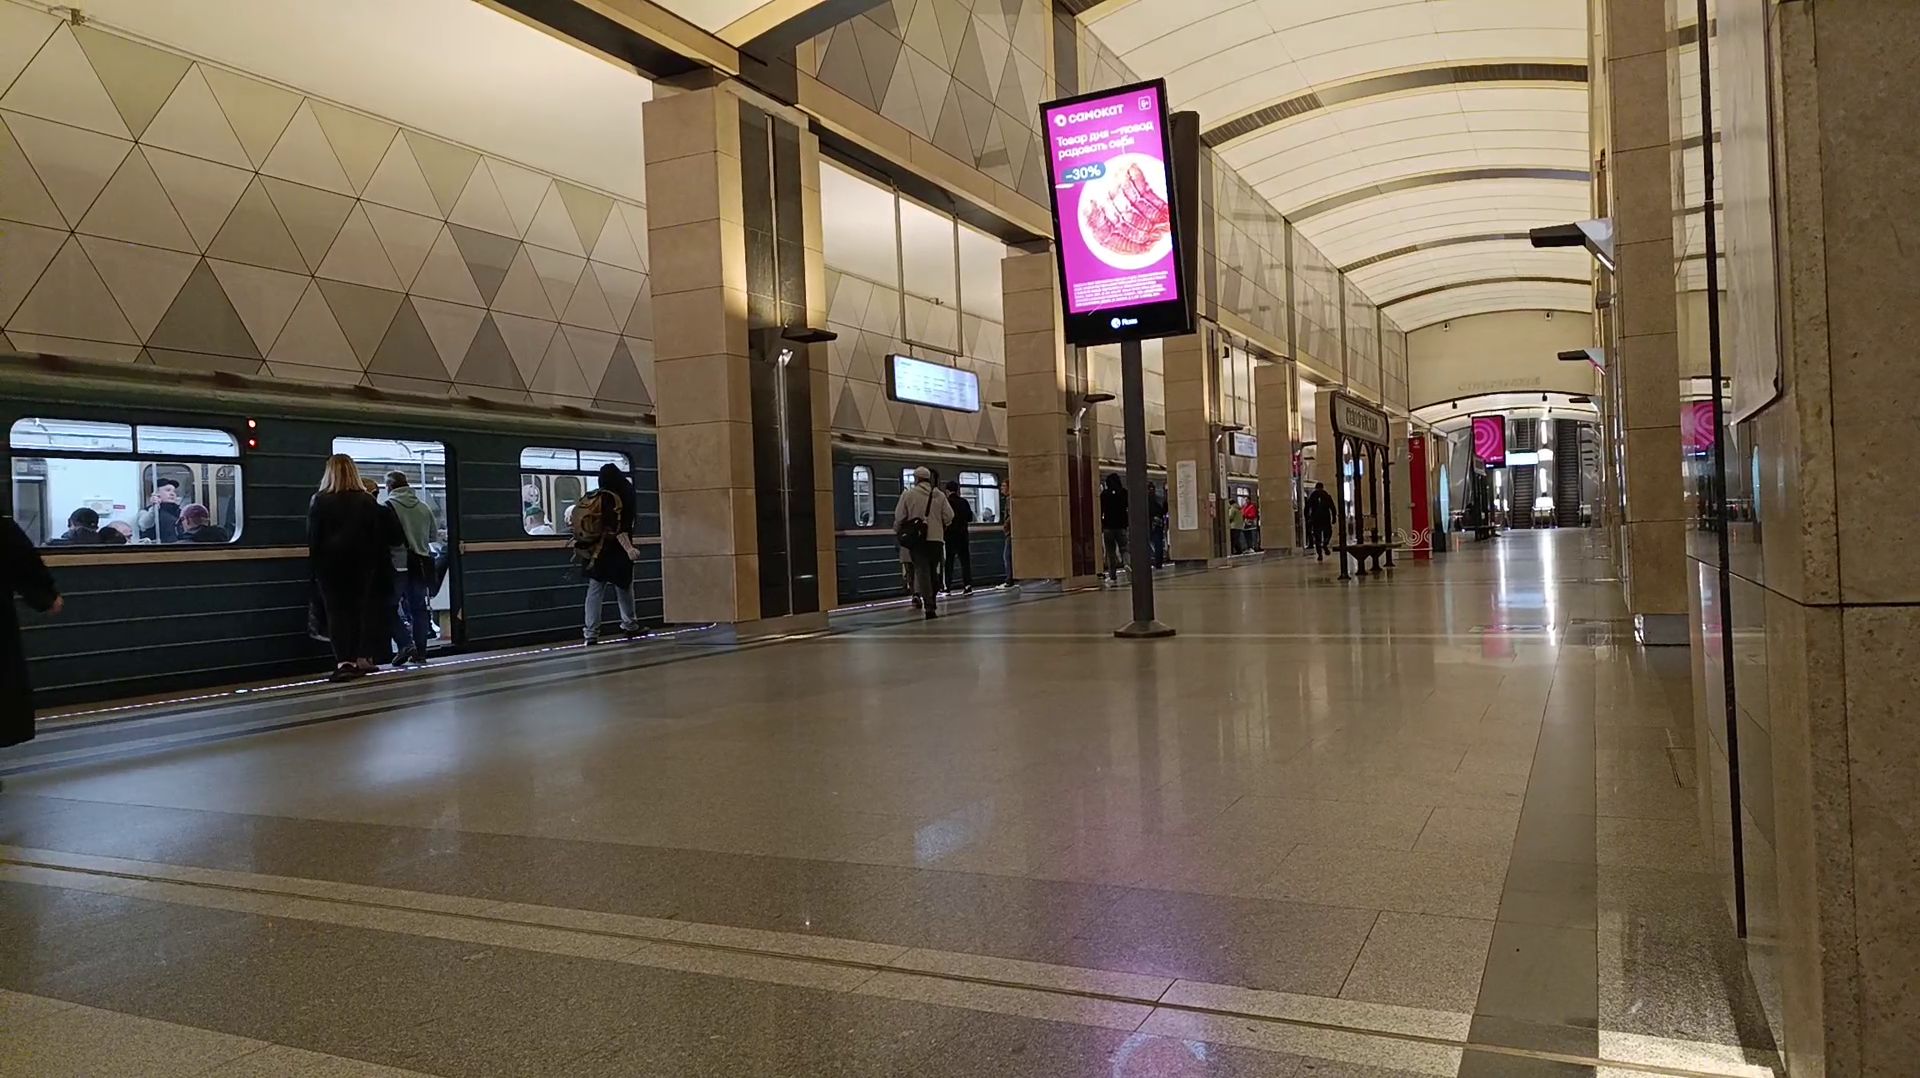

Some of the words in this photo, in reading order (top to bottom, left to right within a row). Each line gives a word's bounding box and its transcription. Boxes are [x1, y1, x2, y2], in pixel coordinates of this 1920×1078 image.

[1068, 104, 1124, 124] самокат
[1057, 134, 1087, 147] Товар
[1089, 129, 1109, 142] дня
[1120, 121, 1154, 134] повод
[1058, 143, 1107, 160] радовать
[1109, 135, 1134, 148] себя
